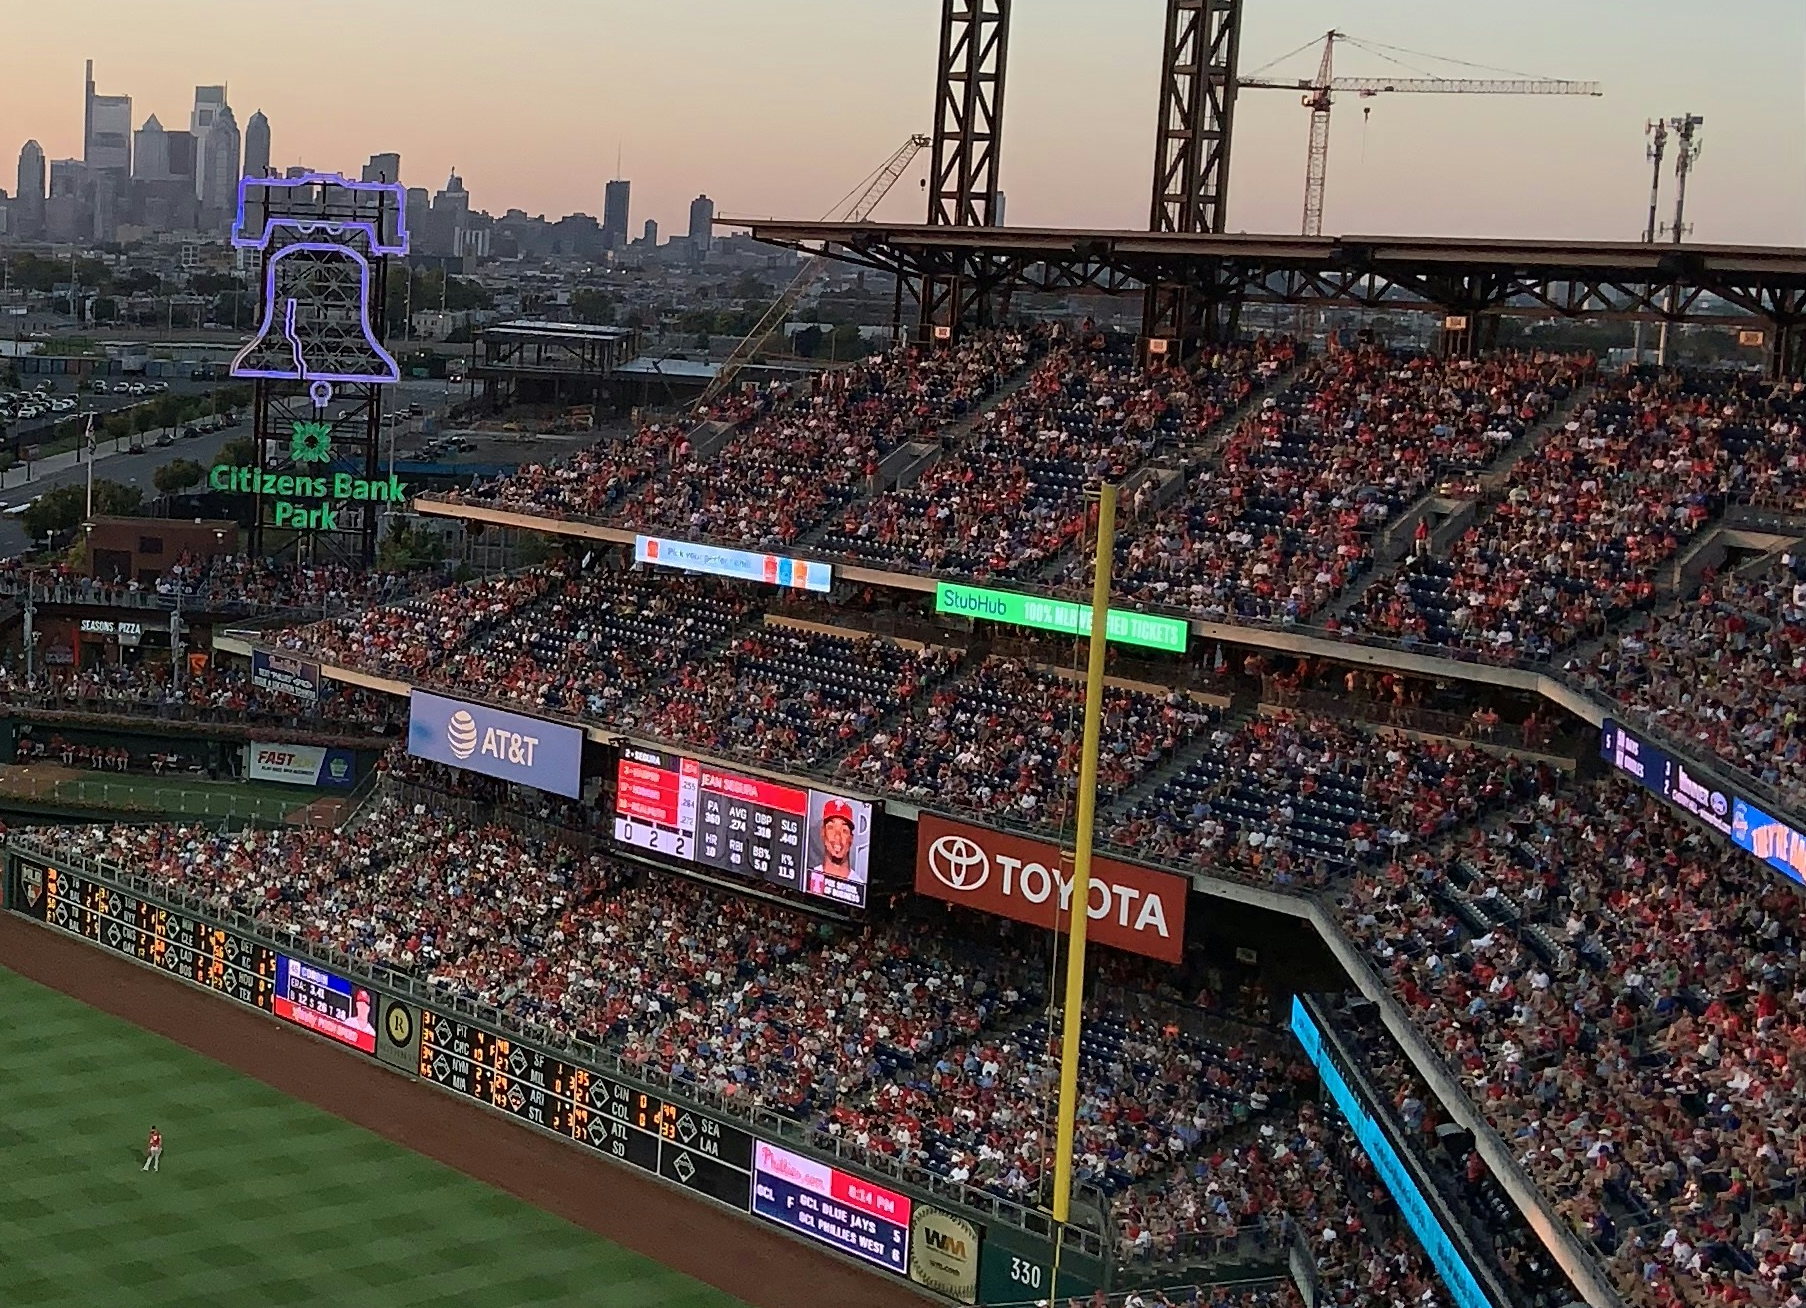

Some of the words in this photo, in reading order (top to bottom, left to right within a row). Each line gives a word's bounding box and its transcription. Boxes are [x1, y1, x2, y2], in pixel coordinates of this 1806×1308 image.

[209, 464, 326, 498] Citizens
[335, 472, 408, 503] Bank
[275, 501, 338, 531] Park
[944, 589, 1007, 615] StubHub
[481, 726, 538, 767] AT&T
[707, 800, 719, 813] PA
[729, 806, 748, 820] AVG
[781, 819, 797, 832] SLG
[995, 854, 1170, 938] TOYOTA
[239, 987, 251, 1002] TEX
[454, 1040, 470, 1056] CHC
[453, 1075, 466, 1091] MIA
[530, 1090, 544, 1105] ARI
[614, 1084, 630, 1102] CIN
[529, 1107, 544, 1124] STL
[612, 1102, 629, 1120] COL
[610, 1122, 628, 1140] ATL
[701, 1118, 720, 1138] SEA
[612, 1140, 625, 1157] SD
[700, 1137, 719, 1156] LAA
[800, 1194, 819, 1212] GCL
[822, 1202, 848, 1223] BLUE
[851, 1214, 876, 1234] JAYS
[876, 1195, 895, 1214] PM
[818, 1220, 857, 1245] PHILLIES
[859, 1234, 884, 1256] WEST
[1011, 1256, 1041, 1289] 330
